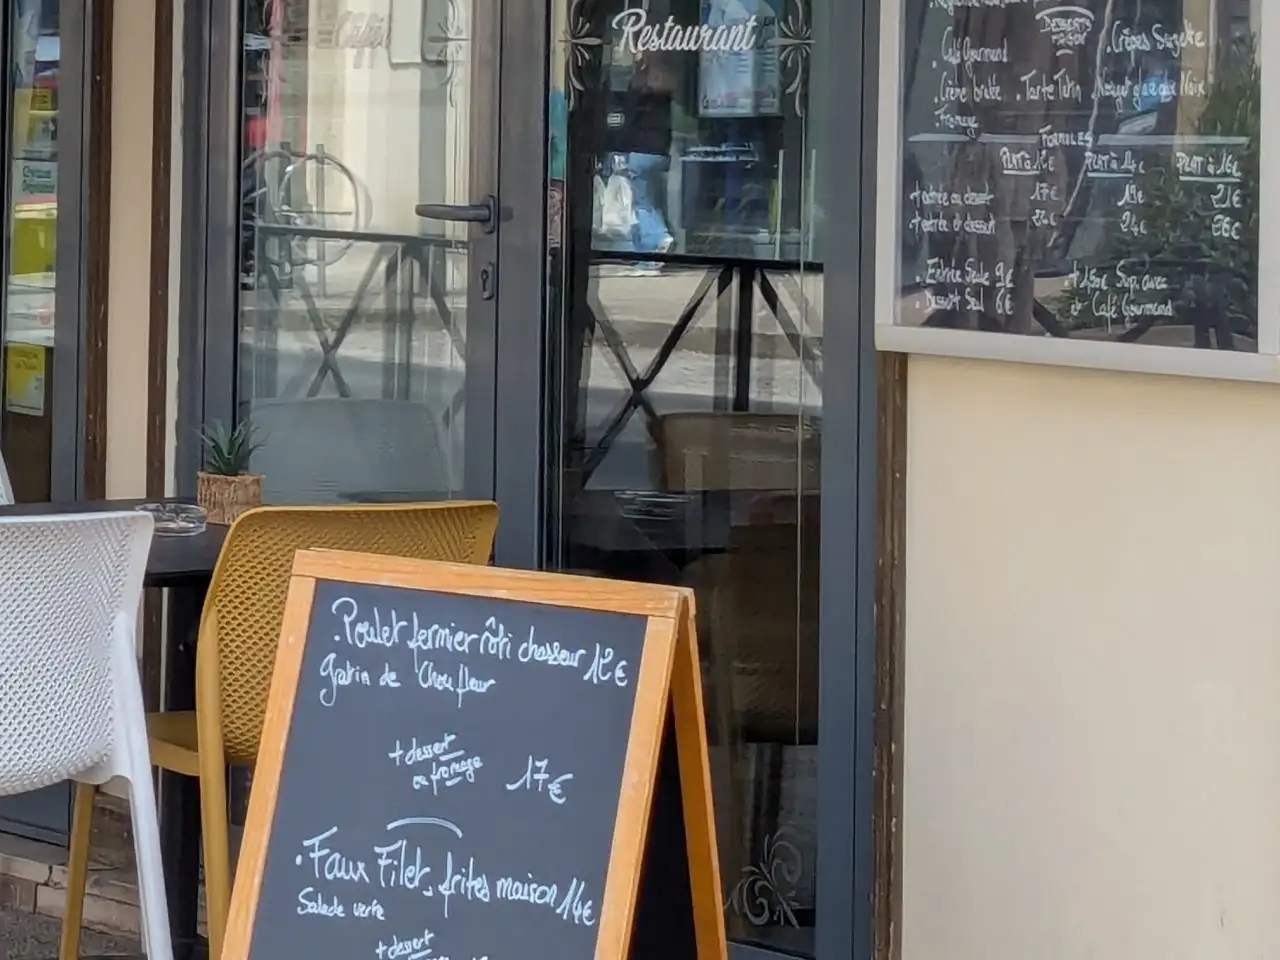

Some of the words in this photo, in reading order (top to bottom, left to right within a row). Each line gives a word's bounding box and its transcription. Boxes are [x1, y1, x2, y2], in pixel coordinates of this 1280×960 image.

[611, 8, 759, 55] Restaurant
[378, 662, 402, 688] de
[302, 826, 372, 884] Faux
